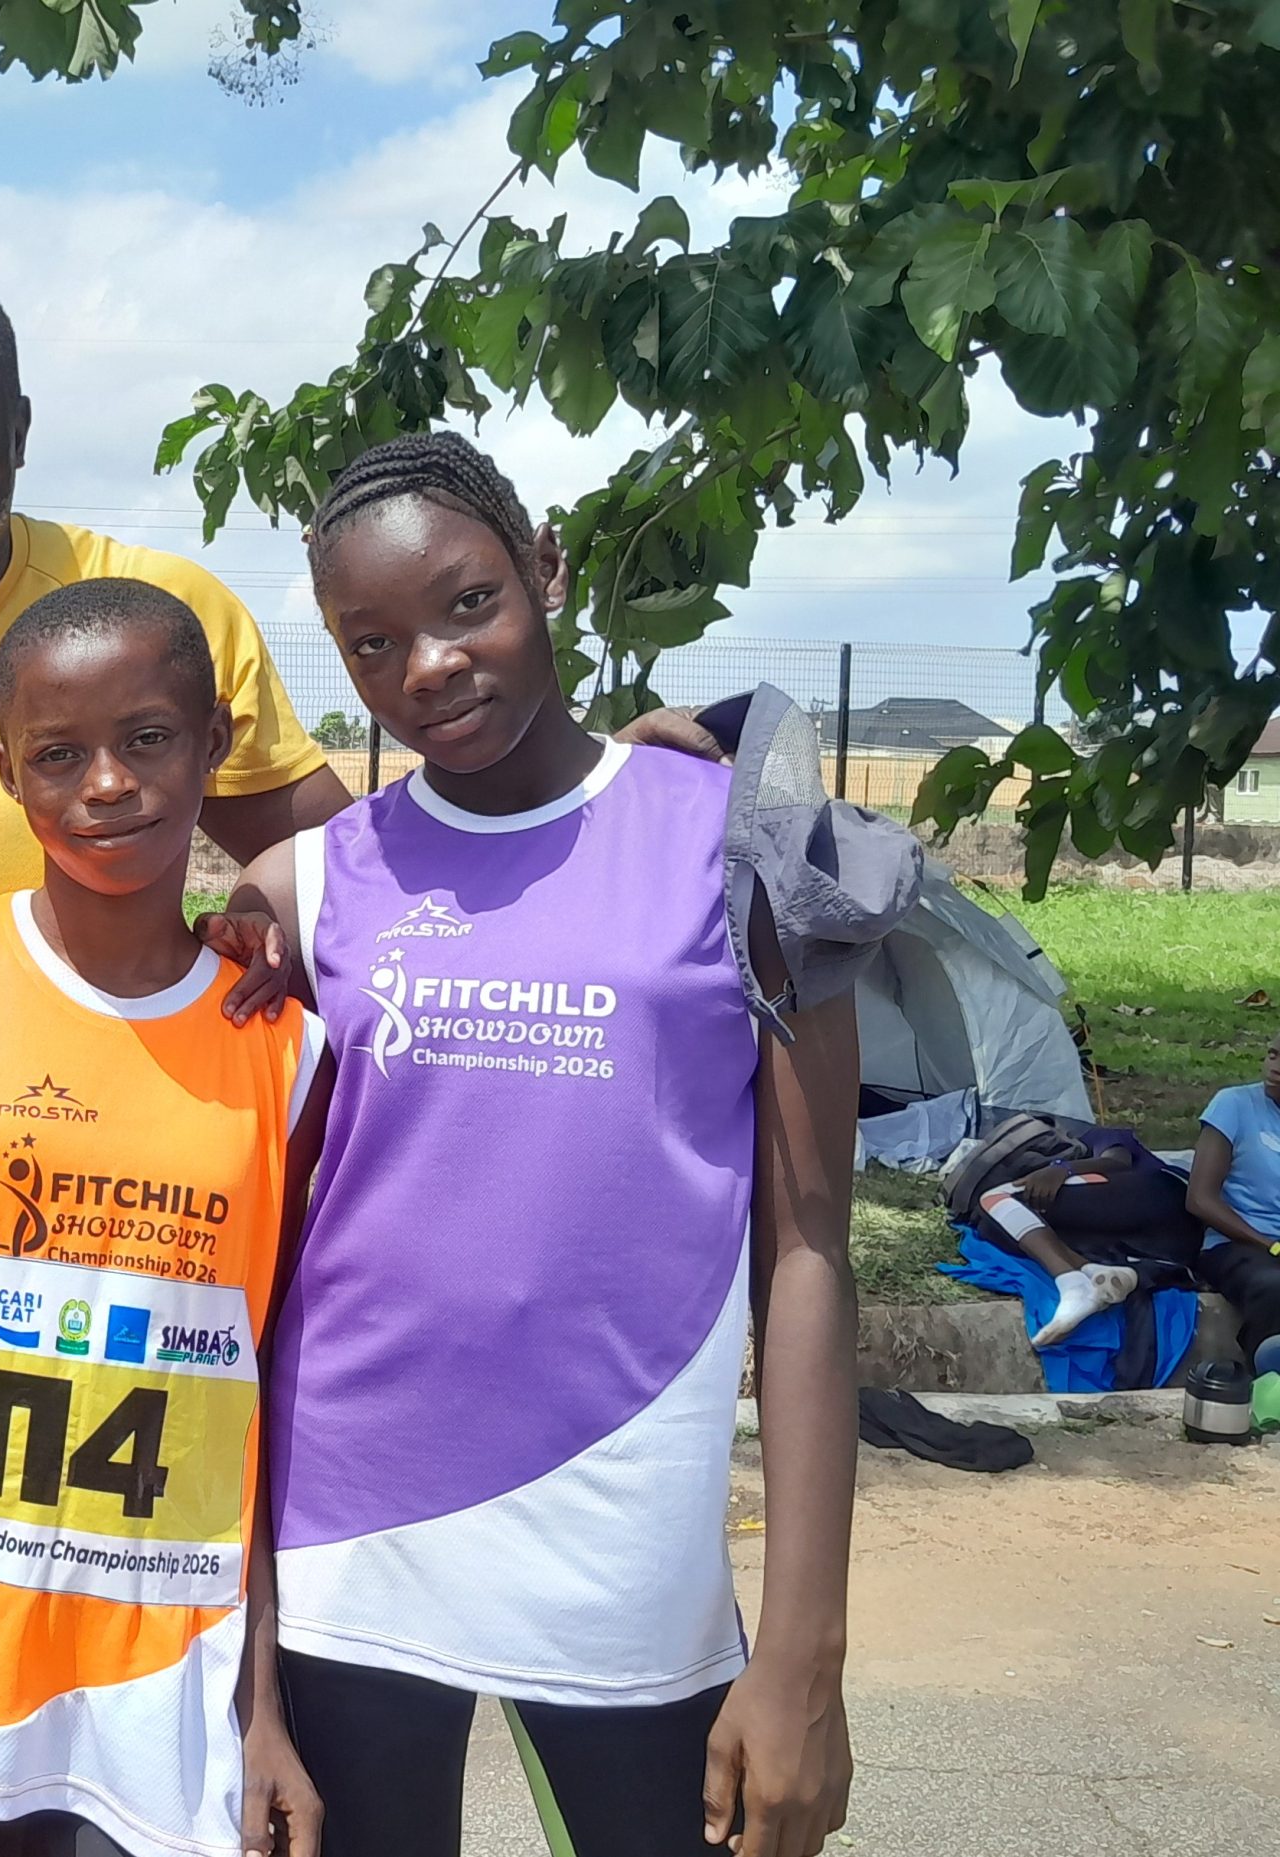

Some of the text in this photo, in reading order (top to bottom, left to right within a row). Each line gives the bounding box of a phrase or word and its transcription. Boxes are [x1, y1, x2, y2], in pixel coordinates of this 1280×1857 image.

[412, 977, 616, 1017] FITCHILD
[412, 1048, 615, 1079] Championship 2026
[50, 1172, 229, 1225] FITCHILD
[47, 1245, 218, 1284] Championship 2026
[161, 1325, 222, 1355] SIMBA
[182, 1352, 221, 1366] PLANET
[49, 1540, 180, 1579] Championship
[181, 1553, 221, 1576] 2026
